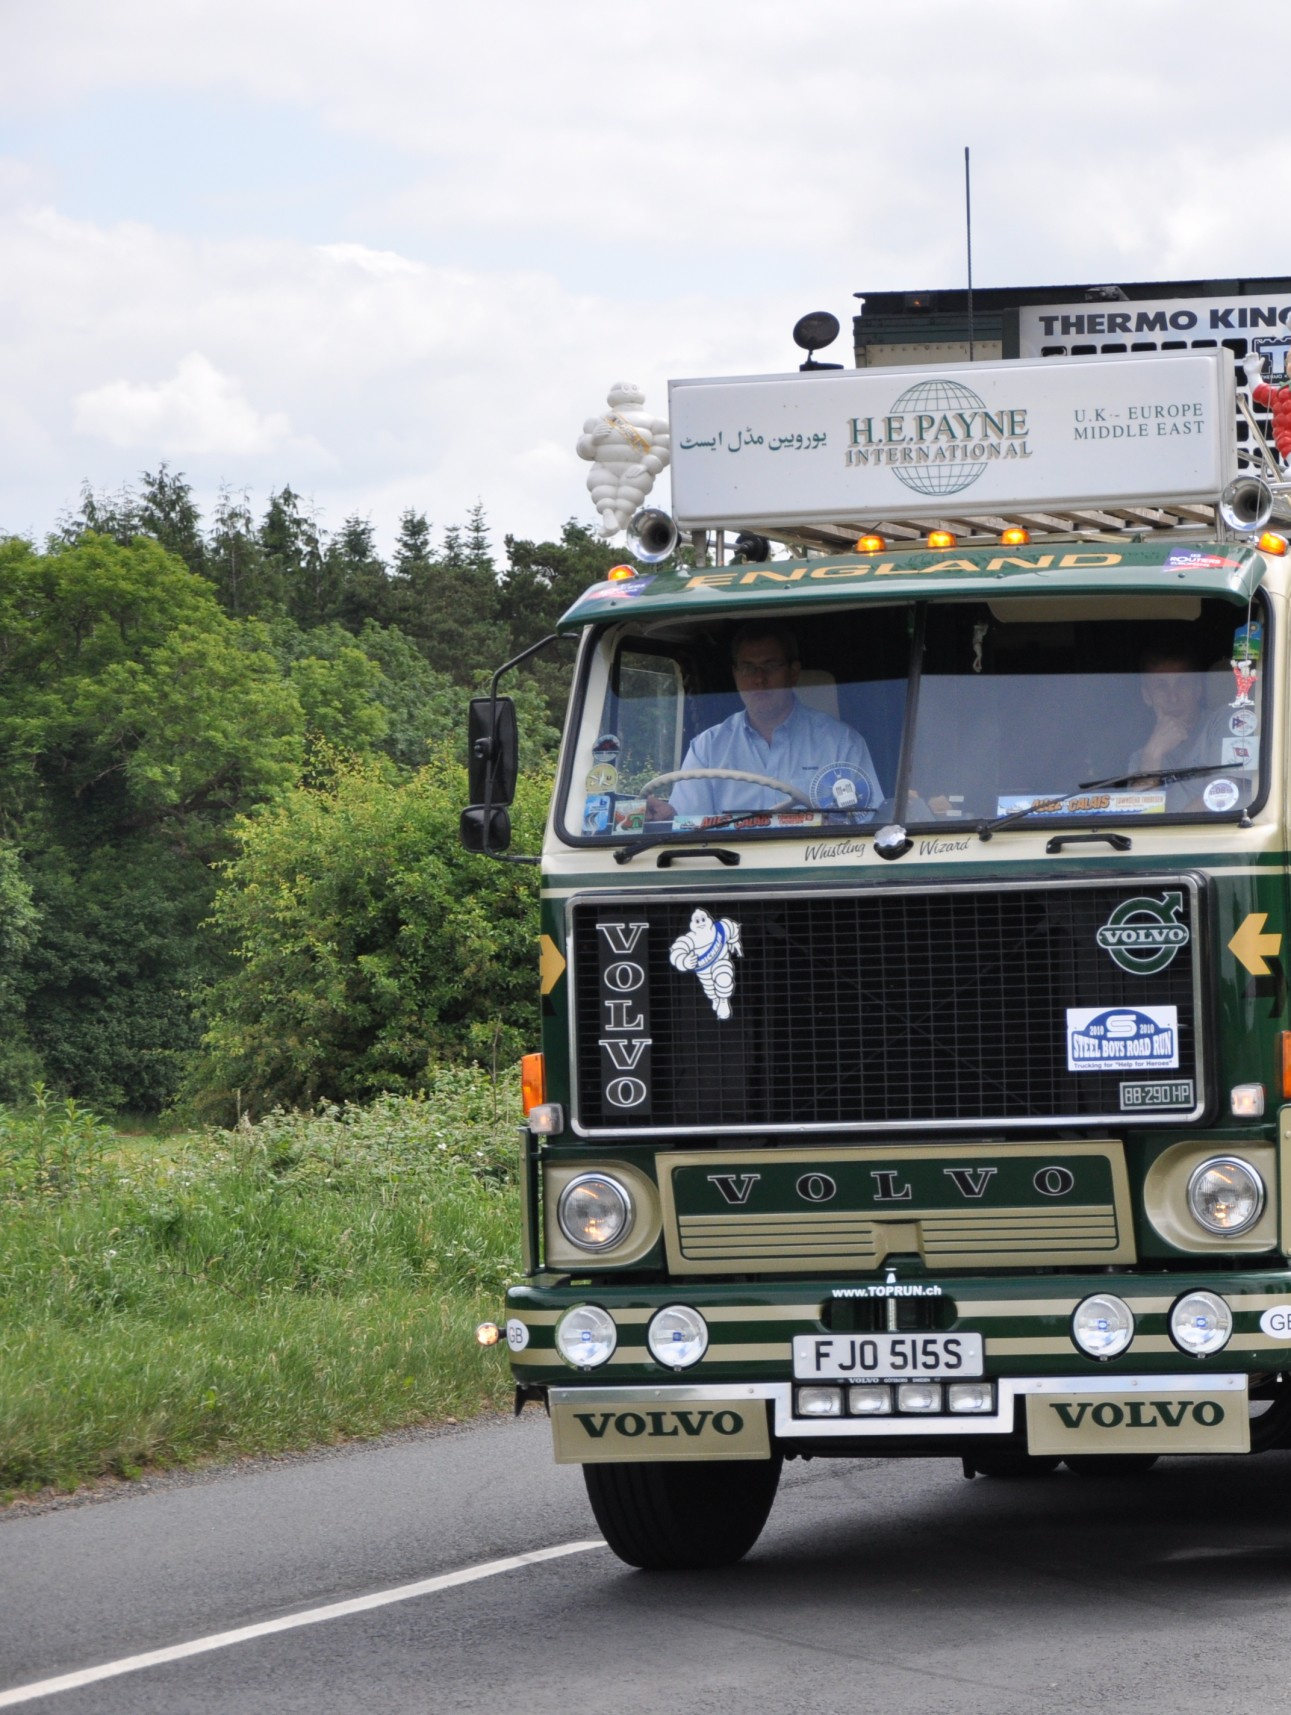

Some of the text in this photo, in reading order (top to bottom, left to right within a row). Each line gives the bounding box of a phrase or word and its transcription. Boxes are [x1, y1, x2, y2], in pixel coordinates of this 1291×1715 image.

[1039, 310, 1198, 336] THERMO
[1127, 403, 1204, 419] EUROPE
[848, 409, 1030, 446] H.E.PAYNE
[1074, 420, 1205, 440] MIDDLE EAST
[846, 441, 1033, 467] INTERNATIONAL
[686, 553, 1122, 588] ENGLAND
[805, 837, 971, 862] Whistling Wizard
[1102, 928, 1184, 944] VOLVO
[596, 922, 652, 1108] VOLVO
[1089, 1025, 1104, 1036] 2010
[1139, 1024, 1155, 1034] 2010
[1073, 1030, 1172, 1058] STEEL BOYS ROAD RUN
[1074, 1062, 1102, 1070] Trucking
[1124, 1085, 1189, 1105] 88-290 HP
[707, 1165, 1075, 1205] VOLVO
[832, 1285, 942, 1298] www.TOPRUN.ch
[509, 1327, 523, 1344] GB
[814, 1338, 962, 1372] FJO 515S
[573, 1410, 744, 1438] VOLVO
[1049, 1400, 1225, 1428] VOLVO
